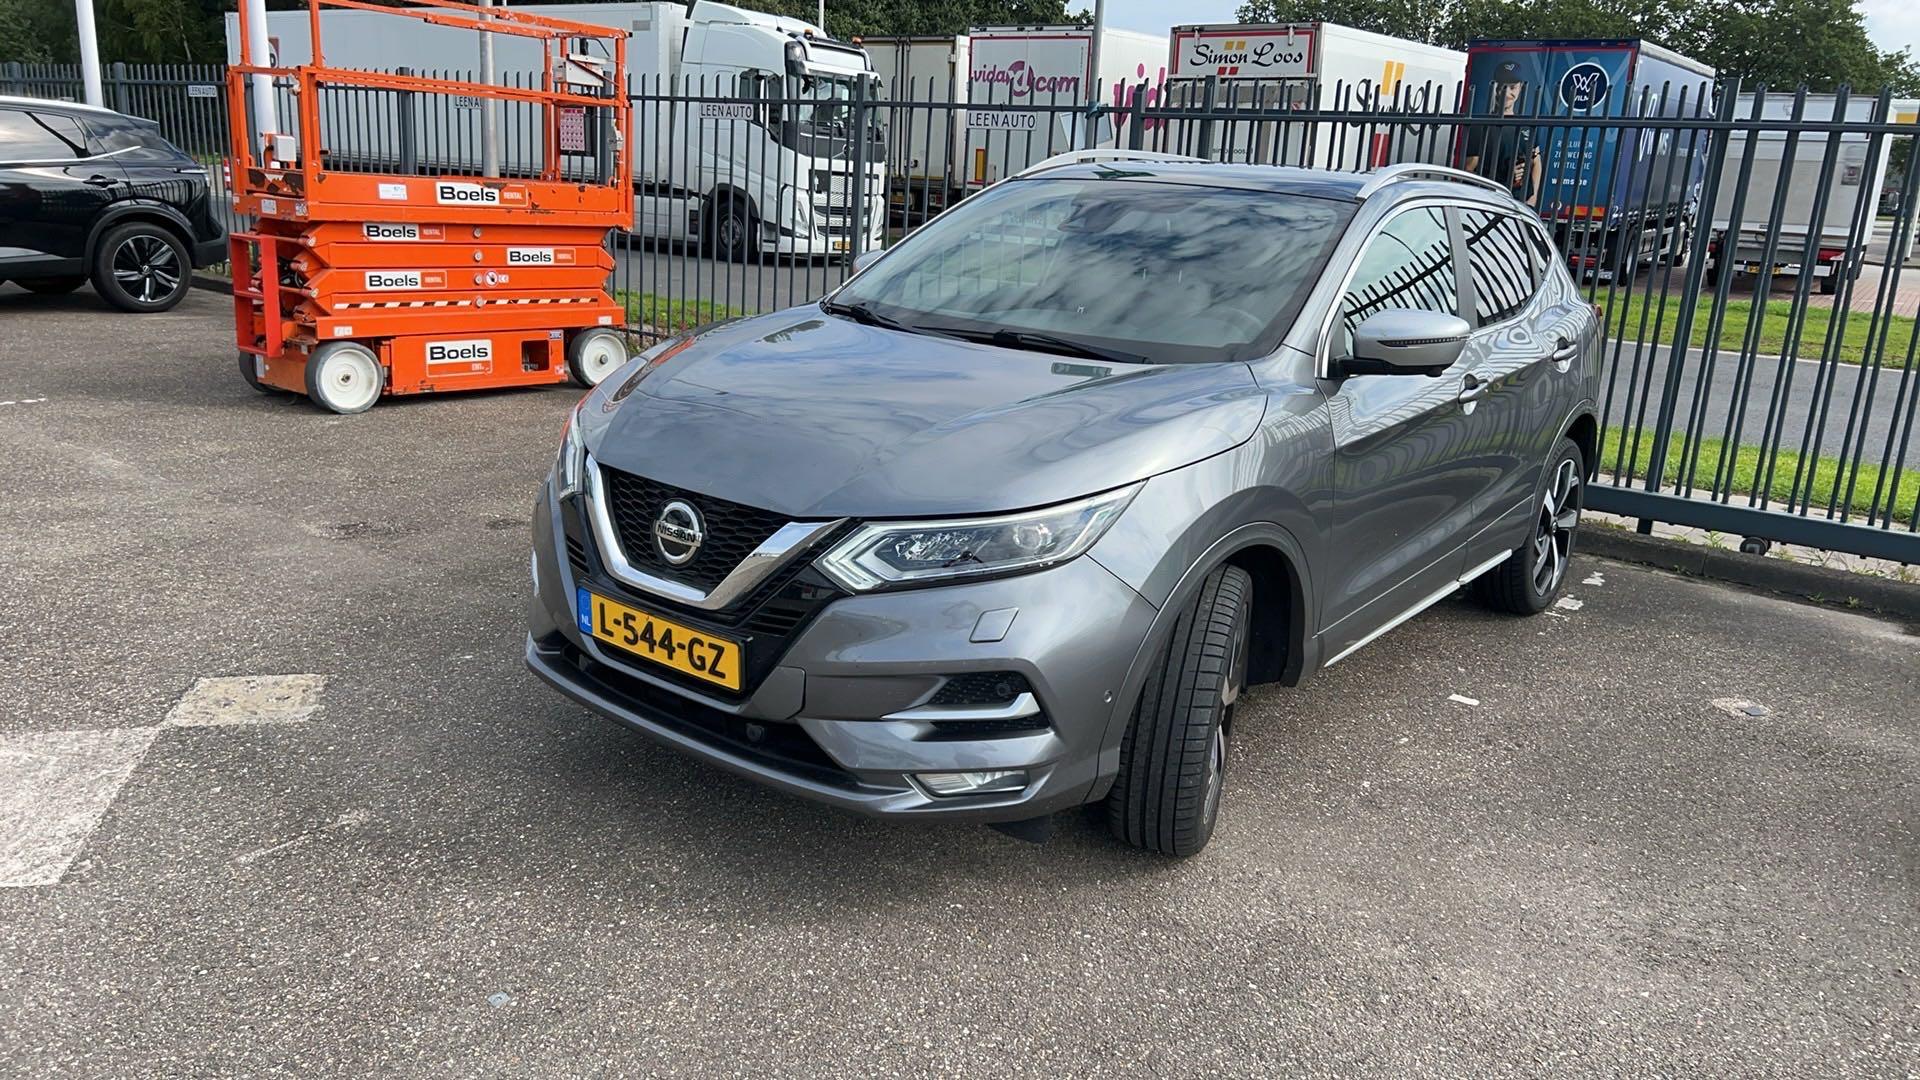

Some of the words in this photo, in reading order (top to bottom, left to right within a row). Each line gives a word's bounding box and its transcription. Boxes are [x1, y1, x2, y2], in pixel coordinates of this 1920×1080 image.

[1190, 43, 1248, 66] Simon
[1251, 42, 1304, 67] Loos
[439, 186, 496, 202] Boels
[366, 225, 417, 238] Boels
[509, 251, 552, 262] Boels
[368, 275, 418, 287] Boels
[429, 344, 489, 361] Boels
[657, 522, 697, 543] NISSAN
[581, 614, 592, 626] NL
[600, 602, 726, 679] L-544-GZ
